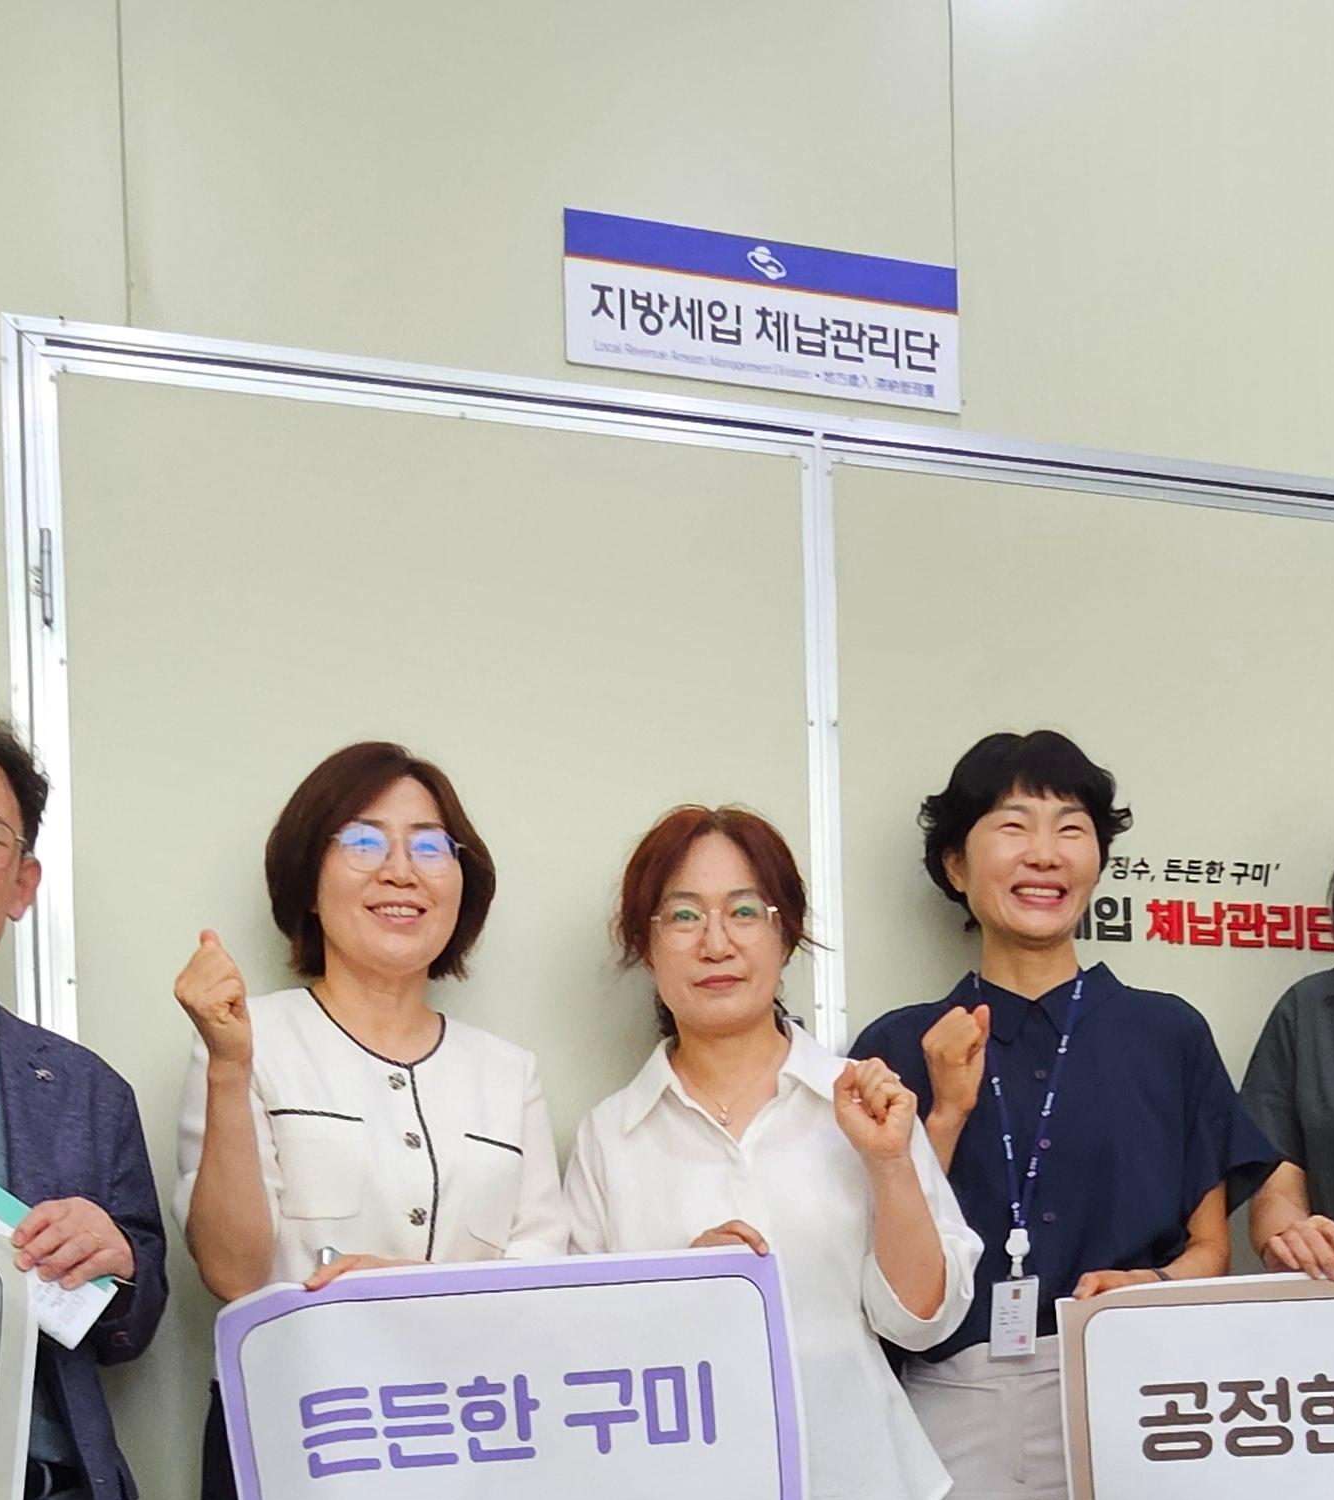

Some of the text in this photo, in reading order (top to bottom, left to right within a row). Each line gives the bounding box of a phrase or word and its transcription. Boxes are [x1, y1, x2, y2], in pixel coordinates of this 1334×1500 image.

[590, 283, 941, 373] 지방세입 체납관리단
[1109, 856, 1156, 883] 징수,
[1162, 858, 1226, 884] 든든한
[298, 1360, 717, 1479] 든든한 구미
